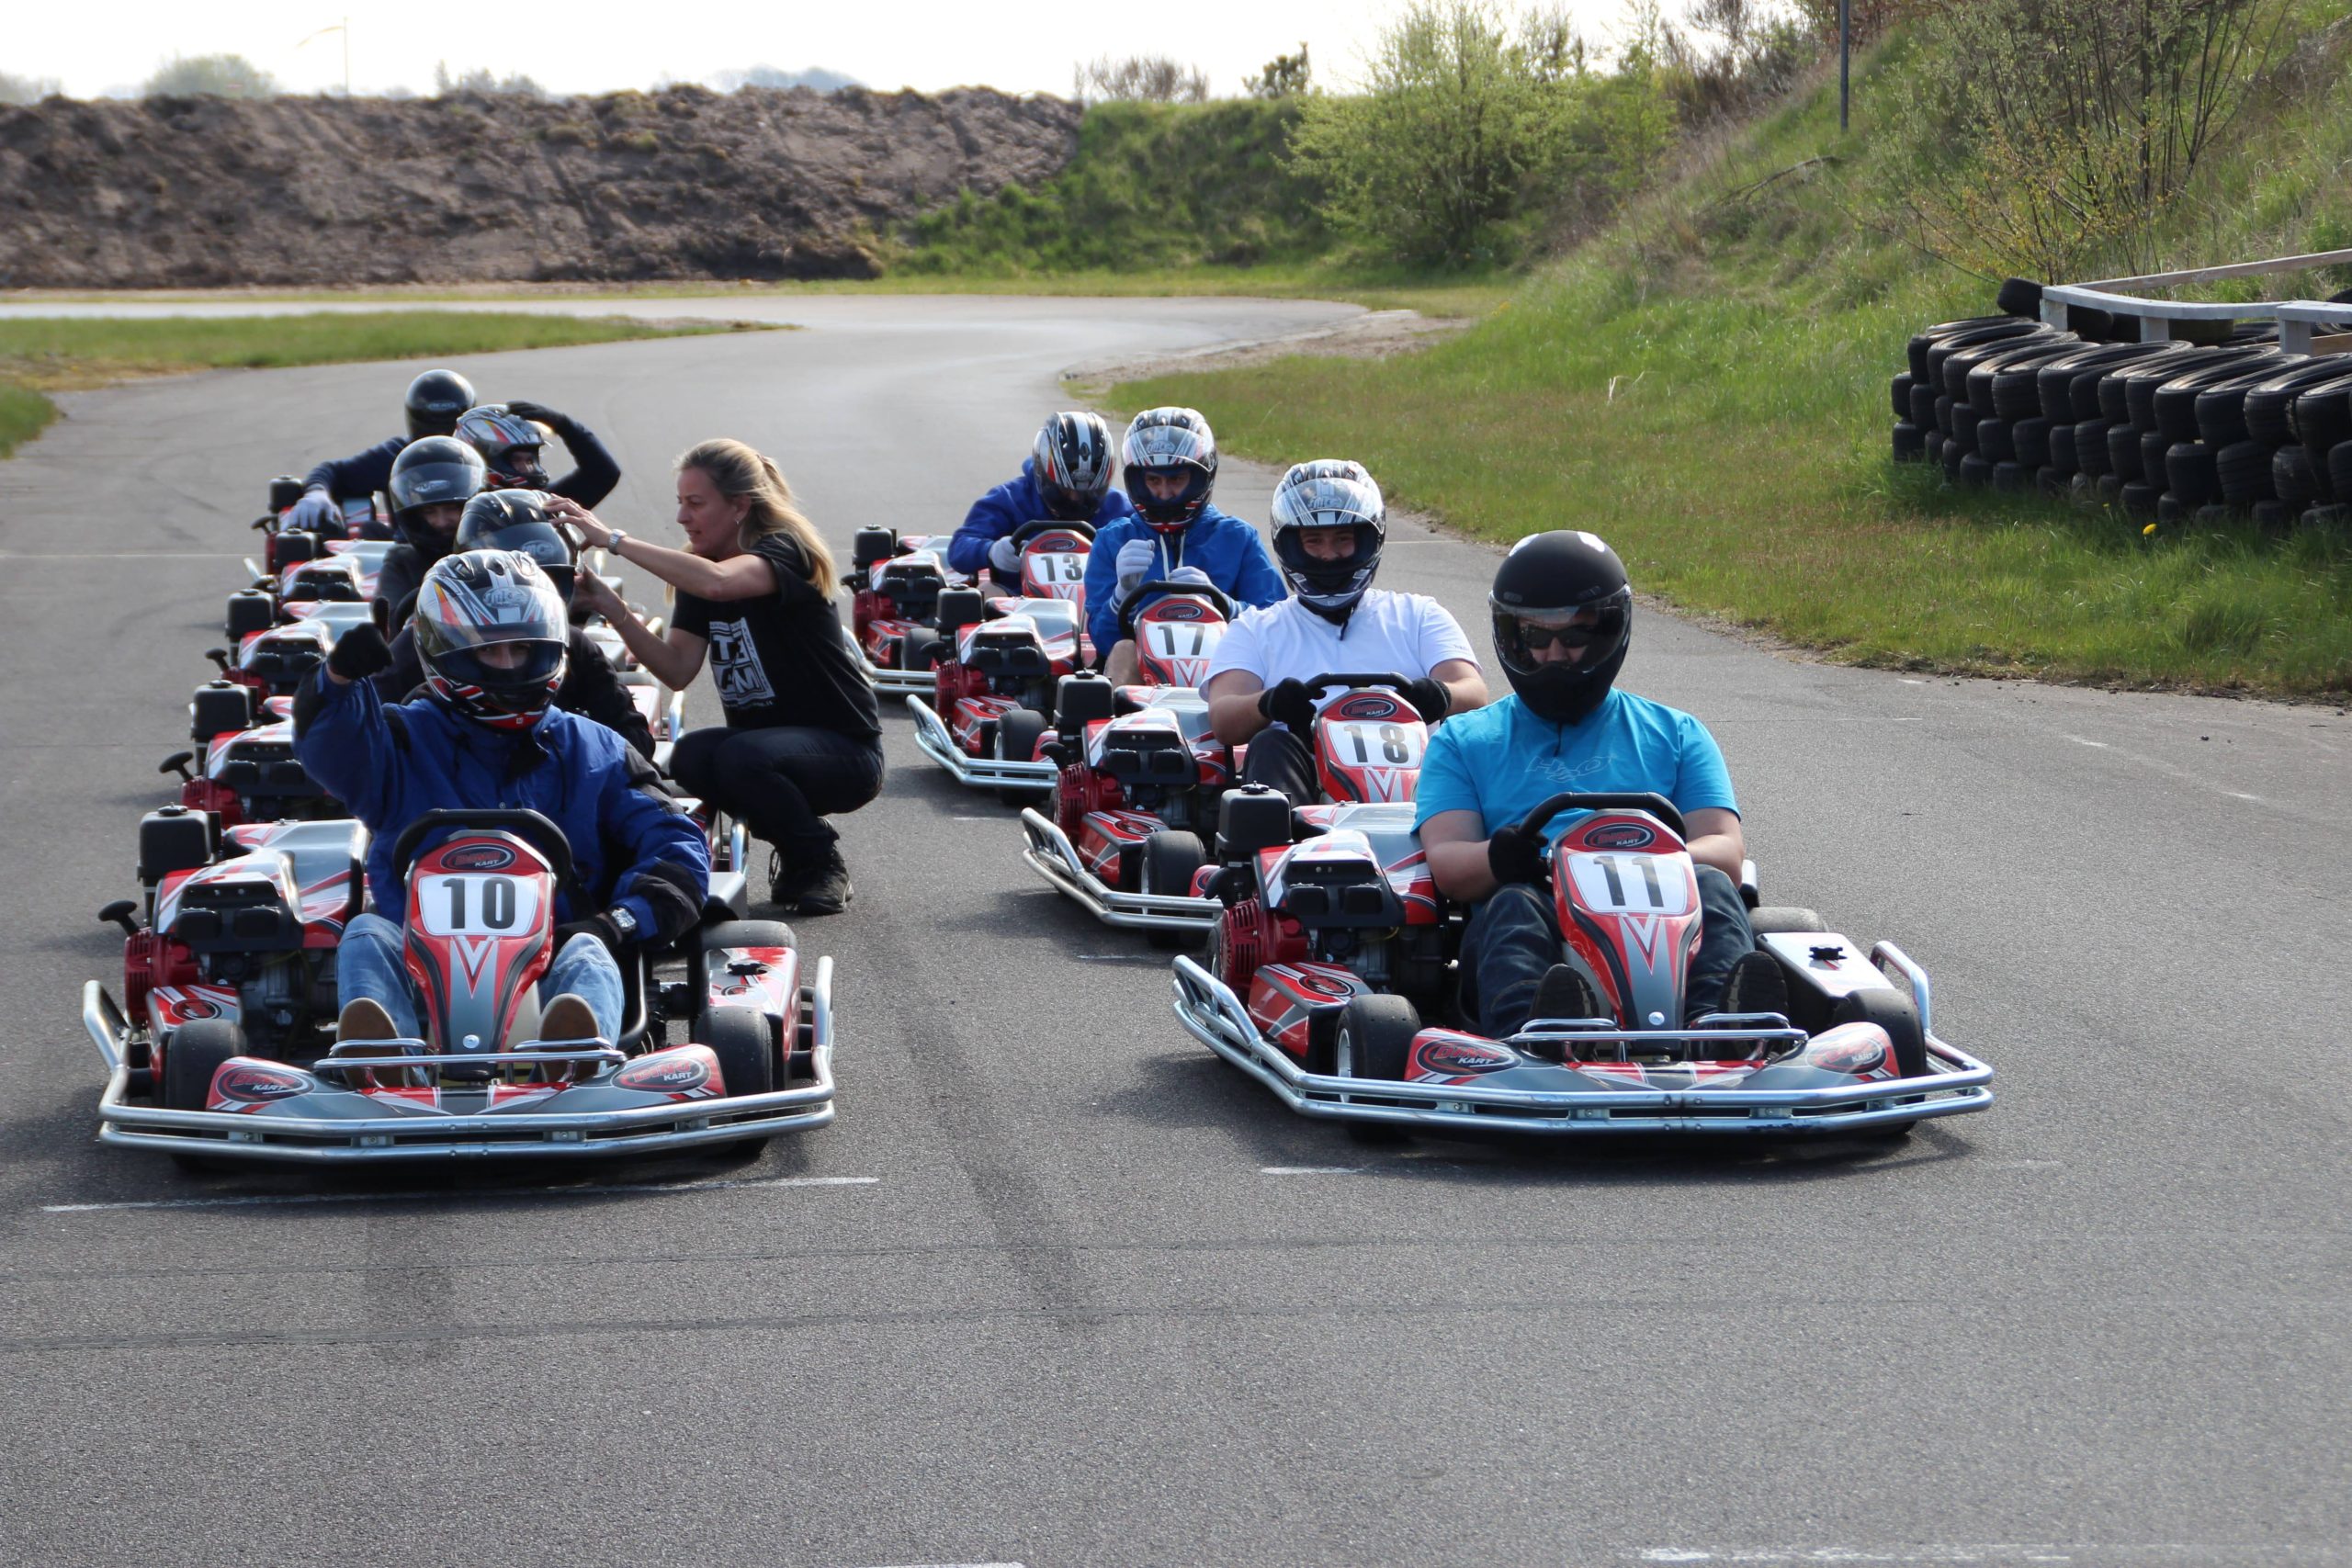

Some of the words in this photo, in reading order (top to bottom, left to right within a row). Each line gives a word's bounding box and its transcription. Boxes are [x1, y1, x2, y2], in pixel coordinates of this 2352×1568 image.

[1040, 554, 1082, 581] 13
[1158, 624, 1205, 656] 17
[1343, 724, 1409, 763] 18
[474, 859, 500, 867] KART
[1593, 855, 1665, 908] 11
[442, 876, 515, 930] 10
[1457, 1056, 1495, 1065] KART
[662, 1071, 692, 1081] KART
